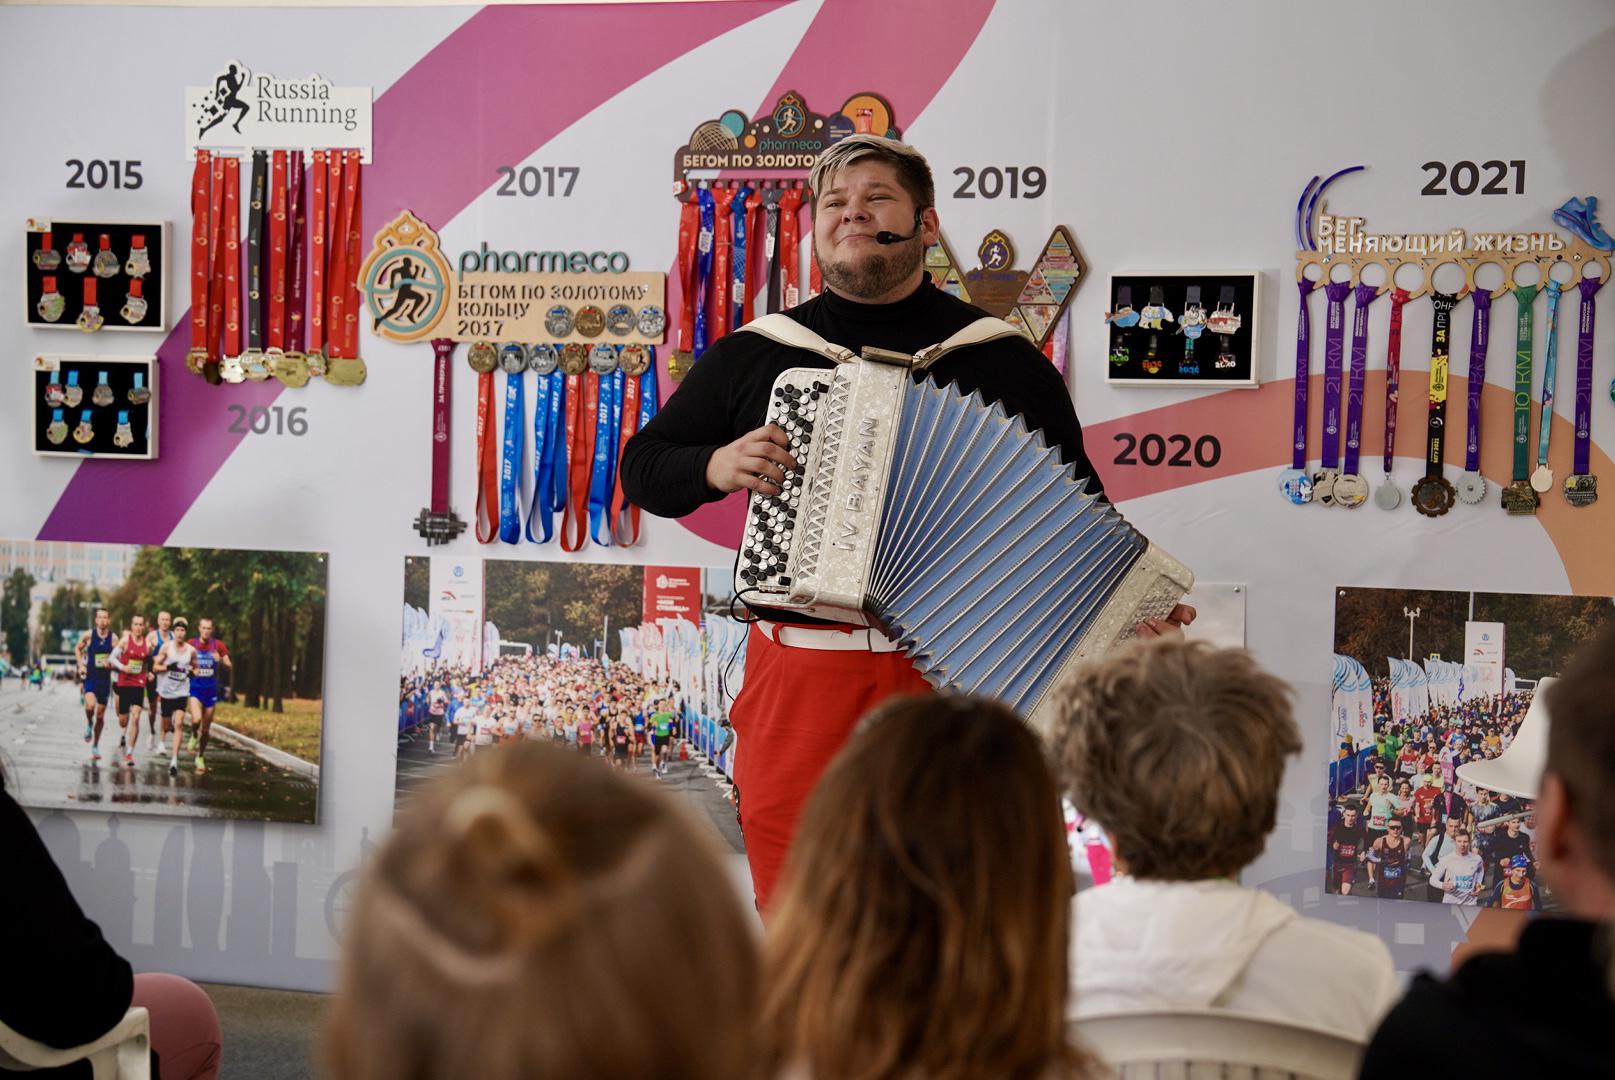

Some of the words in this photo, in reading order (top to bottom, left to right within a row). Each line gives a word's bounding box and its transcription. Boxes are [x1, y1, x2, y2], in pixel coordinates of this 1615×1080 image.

[257, 76, 330, 100] Russia
[257, 101, 358, 131] Running
[759, 137, 821, 153] pharmeco
[683, 154, 729, 167] БЕГОМ
[732, 154, 753, 167] ПО
[65, 159, 143, 189] 2015
[496, 166, 580, 197] 2017
[953, 166, 1047, 199] 2019
[1420, 160, 1526, 196] 2021
[1317, 229, 1465, 256] МЕНЯЮЩИЙ
[1473, 233, 1565, 252] ЖИЗНЬ
[458, 242, 630, 282] pharmeco
[457, 285, 516, 301] БЕГОМ
[521, 285, 545, 301] ПО
[550, 285, 648, 302] ЗОЛОТОМУ
[457, 302, 530, 320] КОЛЬЦУ
[457, 321, 504, 336] 2017
[1435, 330, 1446, 343] ЗА
[626, 378, 635, 400] 2017
[1296, 387, 1306, 402] 21
[1326, 376, 1340, 394] 21
[1349, 387, 1363, 406] 21
[1514, 391, 1531, 412] 10
[228, 405, 309, 436] 2016
[599, 403, 608, 425] 2017
[641, 411, 650, 430] 017
[1113, 432, 1222, 468] 2020
[503, 458, 512, 481] 2017
[845, 417, 878, 512] BAYAN
